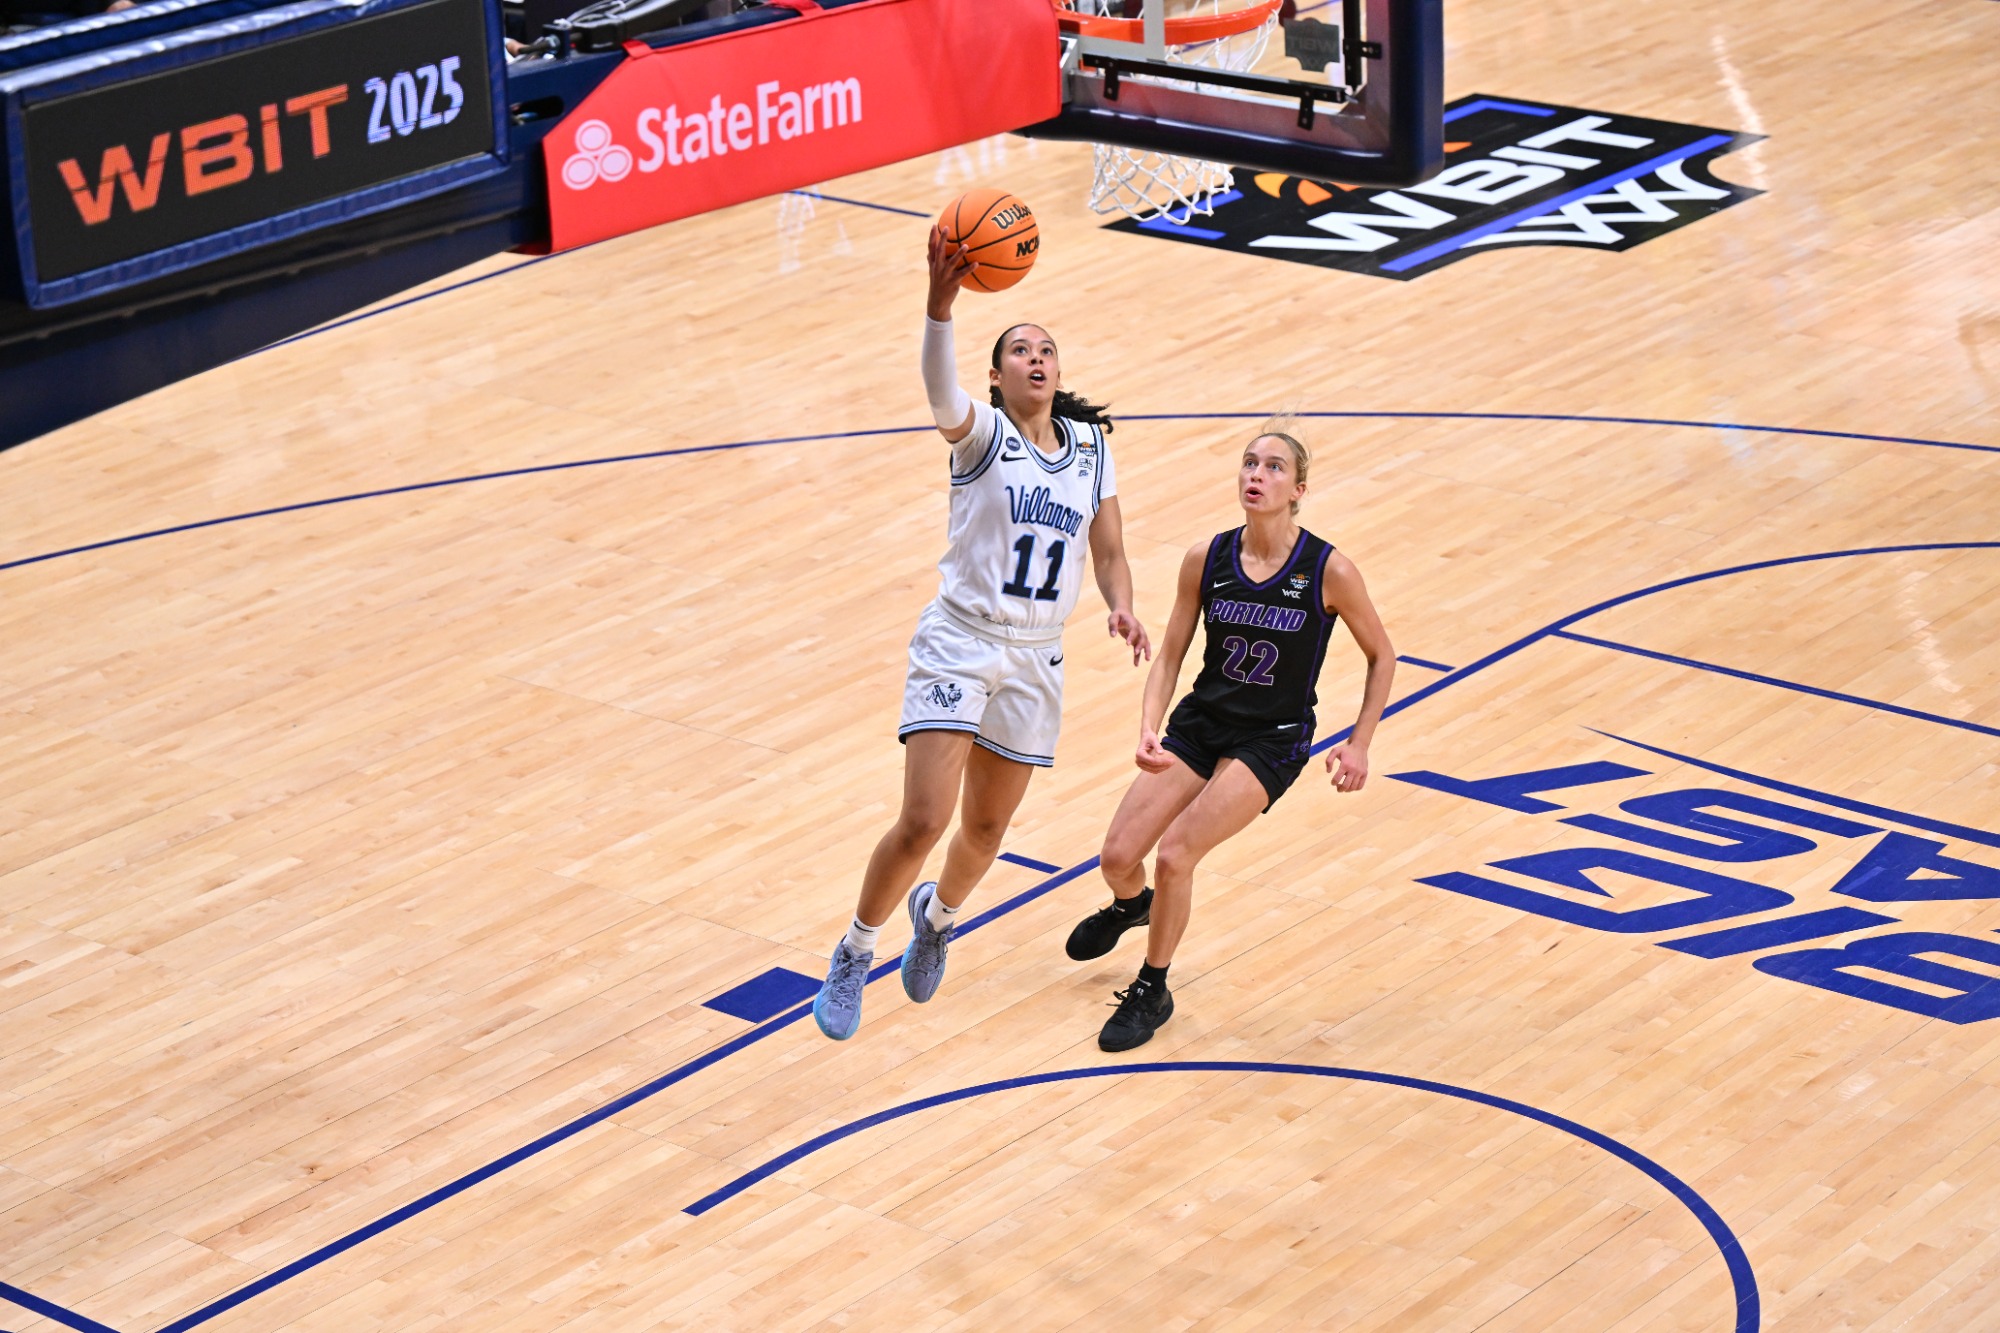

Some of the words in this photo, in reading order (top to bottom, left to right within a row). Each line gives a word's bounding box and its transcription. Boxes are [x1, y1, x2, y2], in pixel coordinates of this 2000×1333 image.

[58, 84, 348, 226] WBIT
[365, 56, 463, 144] 2025
[1249, 115, 1655, 253] WBIT
[1005, 485, 1083, 537] Villanova
[1001, 534, 1065, 602] 11
[1208, 598, 1307, 632] PORTLAND
[1222, 636, 1279, 686] 22
[1383, 760, 2000, 932] AST
[1413, 847, 2000, 1026] BIG
